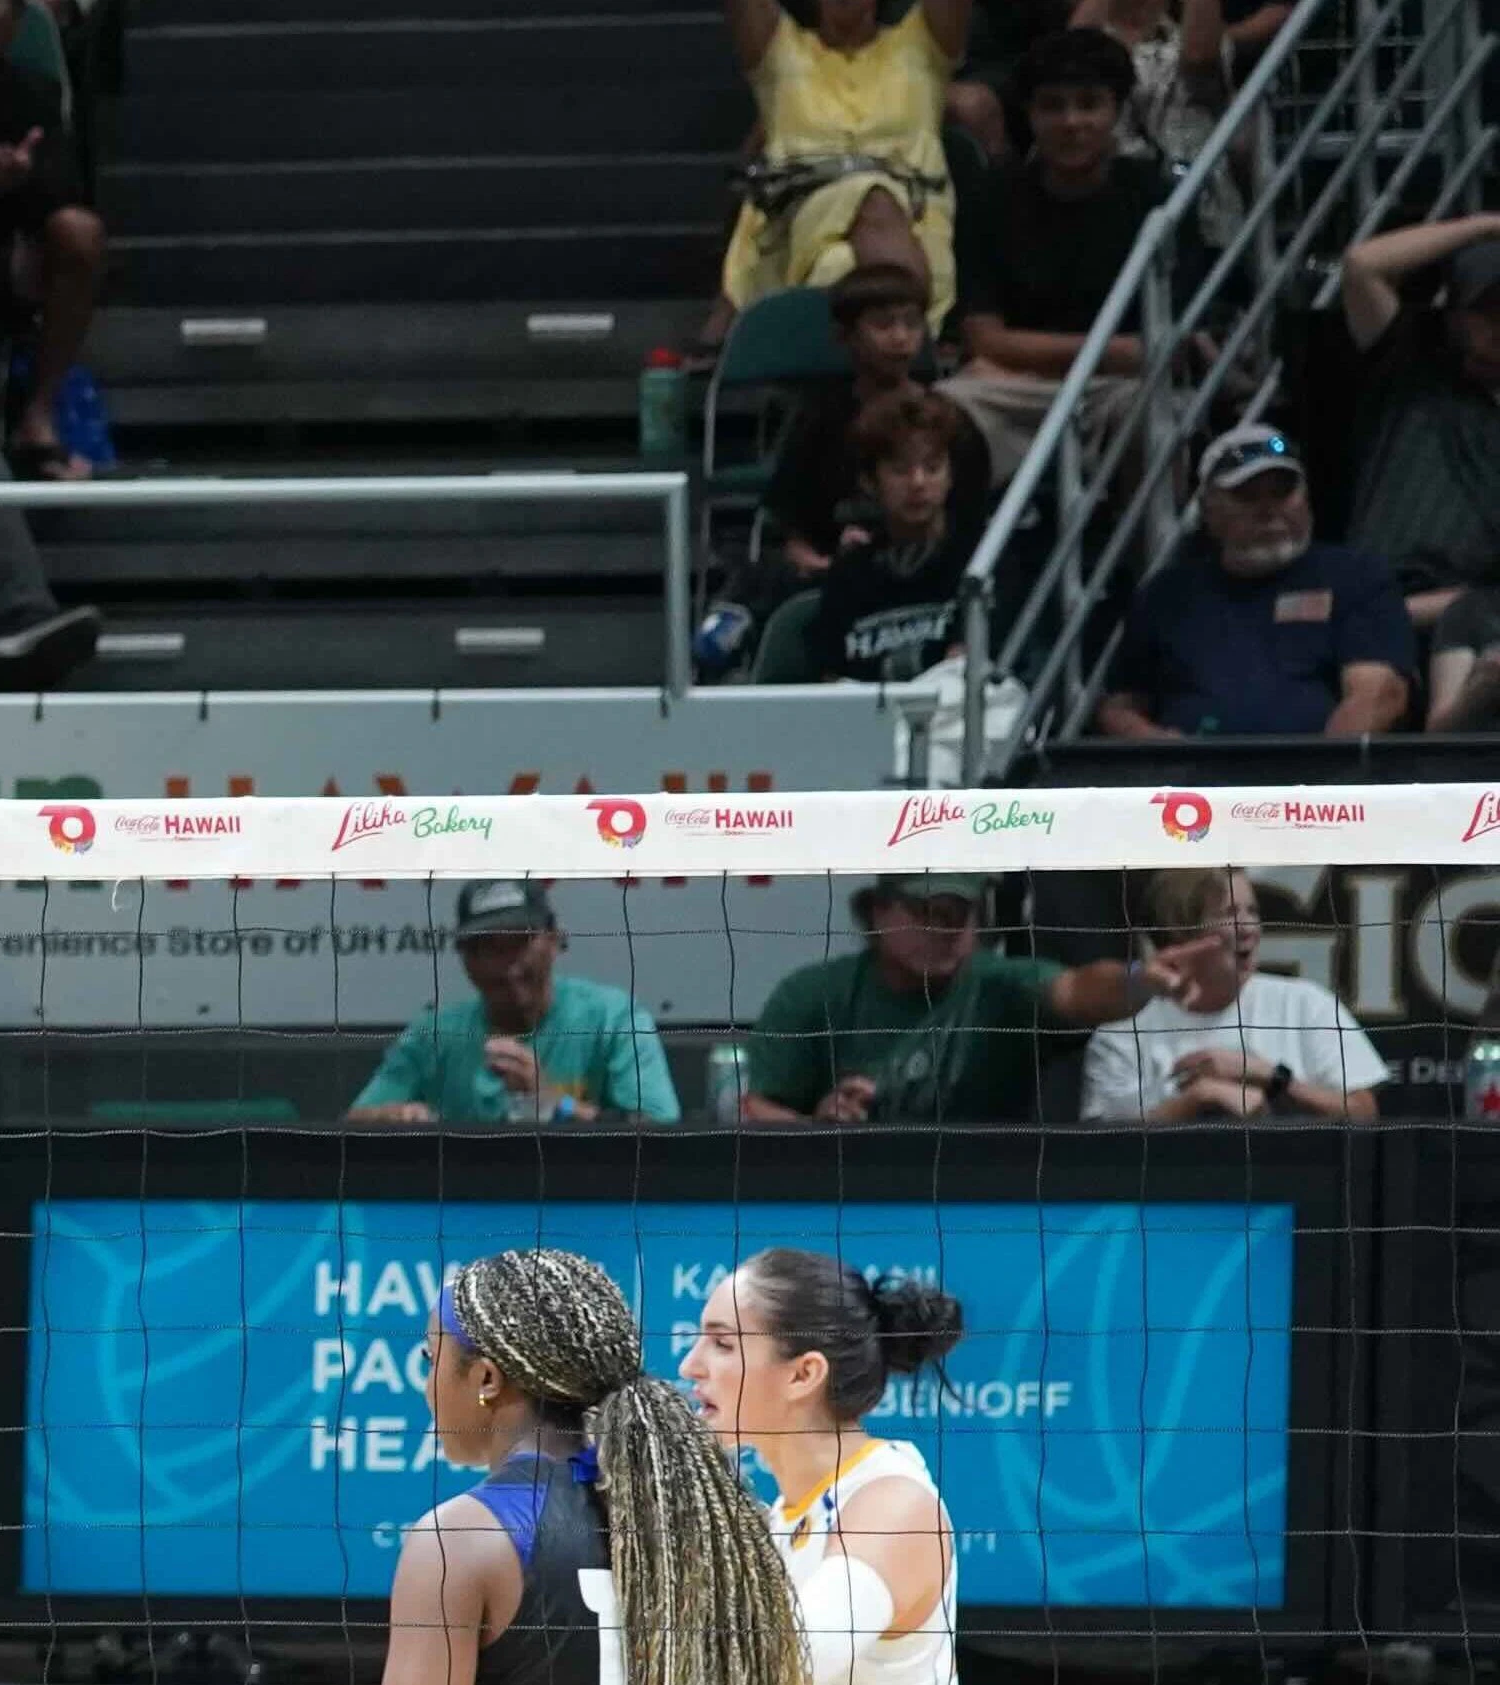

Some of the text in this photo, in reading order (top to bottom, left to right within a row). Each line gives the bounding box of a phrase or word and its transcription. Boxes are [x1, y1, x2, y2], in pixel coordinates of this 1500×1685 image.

[164, 814, 241, 834] HAWAII
[715, 808, 794, 831] HAWAII
[887, 796, 1055, 847] Liliha Bakery
[1284, 801, 1365, 824] HAWAII
[332, 804, 493, 851] Liliha Bakery
[167, 926, 272, 957] Store
